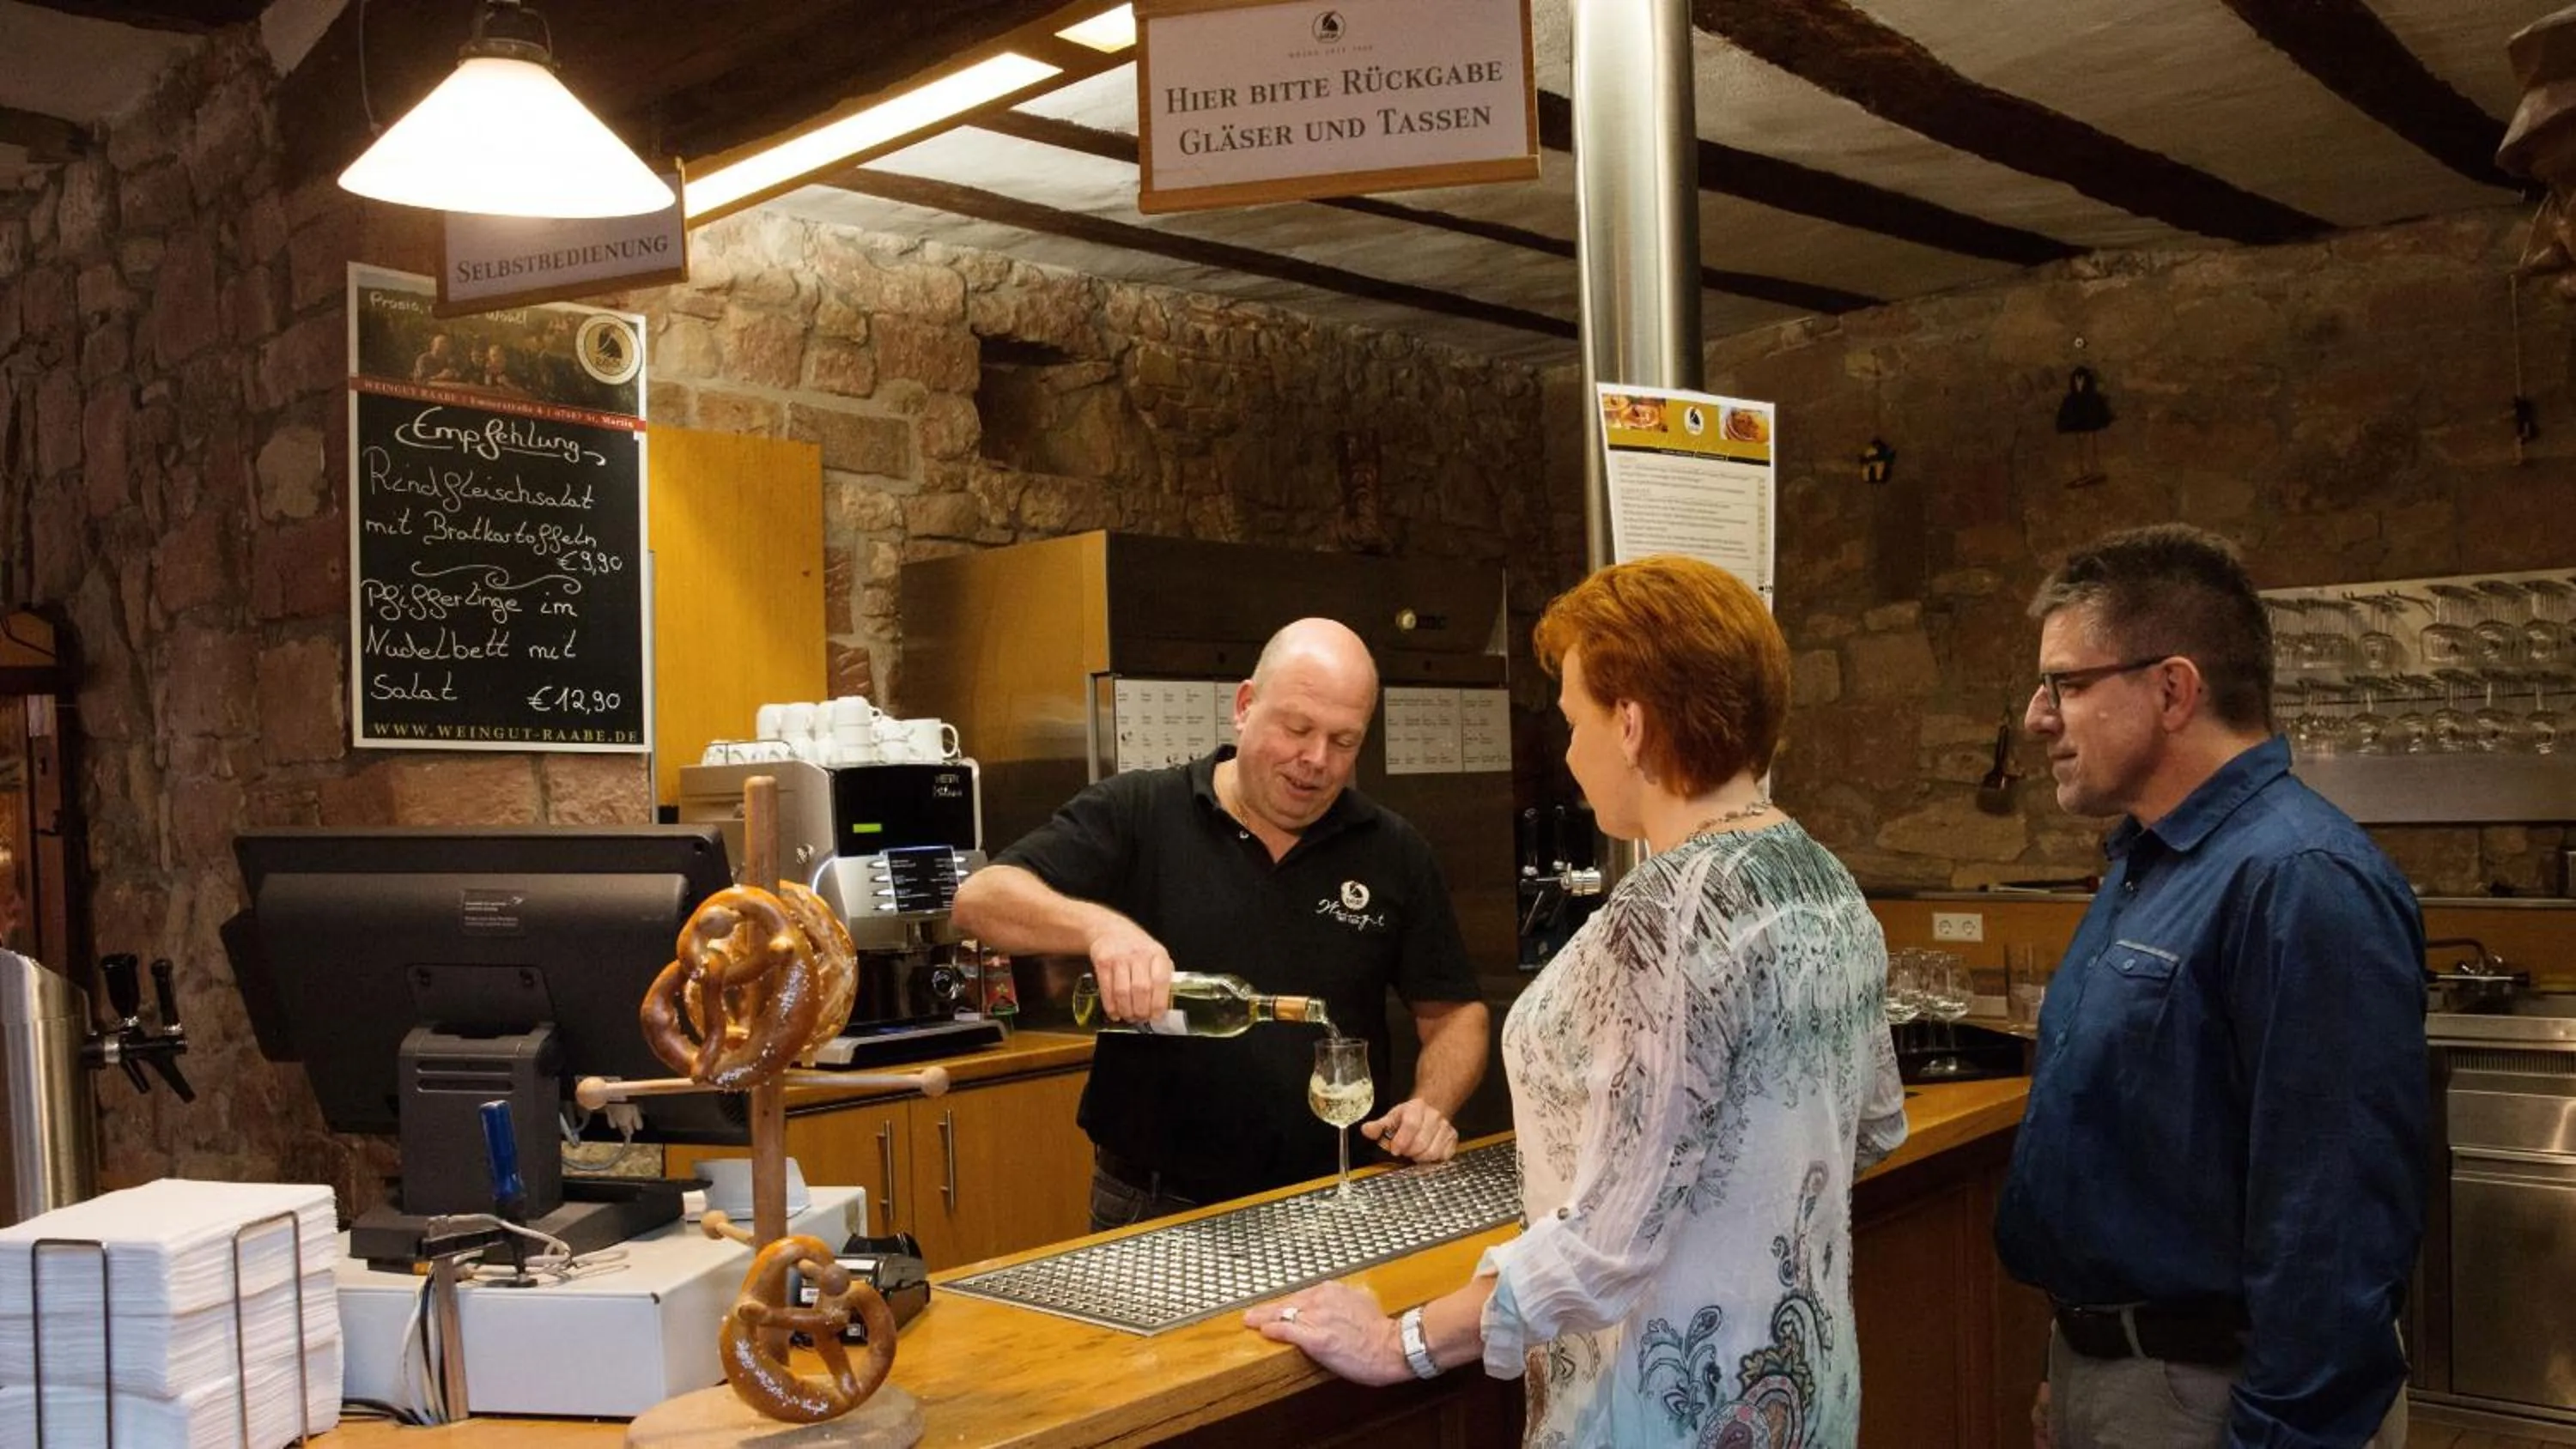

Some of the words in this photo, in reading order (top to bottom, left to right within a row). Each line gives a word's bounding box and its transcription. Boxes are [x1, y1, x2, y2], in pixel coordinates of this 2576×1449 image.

[1165, 86, 1237, 115] HIER
[1250, 76, 1330, 105] BITTE
[1341, 60, 1504, 96] RÜCKGABE
[1179, 123, 1294, 156] GLÄSER
[1305, 116, 1366, 143] UND
[1376, 105, 1492, 136] TASSEN
[456, 234, 670, 284] SELBSTBEDIENUNG
[395, 406, 580, 464] Empfehlung
[602, 416, 634, 428] Martin
[362, 446, 595, 512] Rindfleischsalat
[365, 507, 413, 535] mit
[423, 511, 597, 555] Bratkartoffeln
[556, 550, 623, 576] €9,90
[360, 579, 523, 624] Pfifferlinge
[540, 591, 578, 617] im
[365, 625, 509, 661] Nudelbett
[528, 628, 577, 659] mit
[370, 670, 458, 700] Salat
[526, 686, 622, 715] €12,90
[374, 722, 638, 743] WWW.WEINGUT-RAABE.DE
